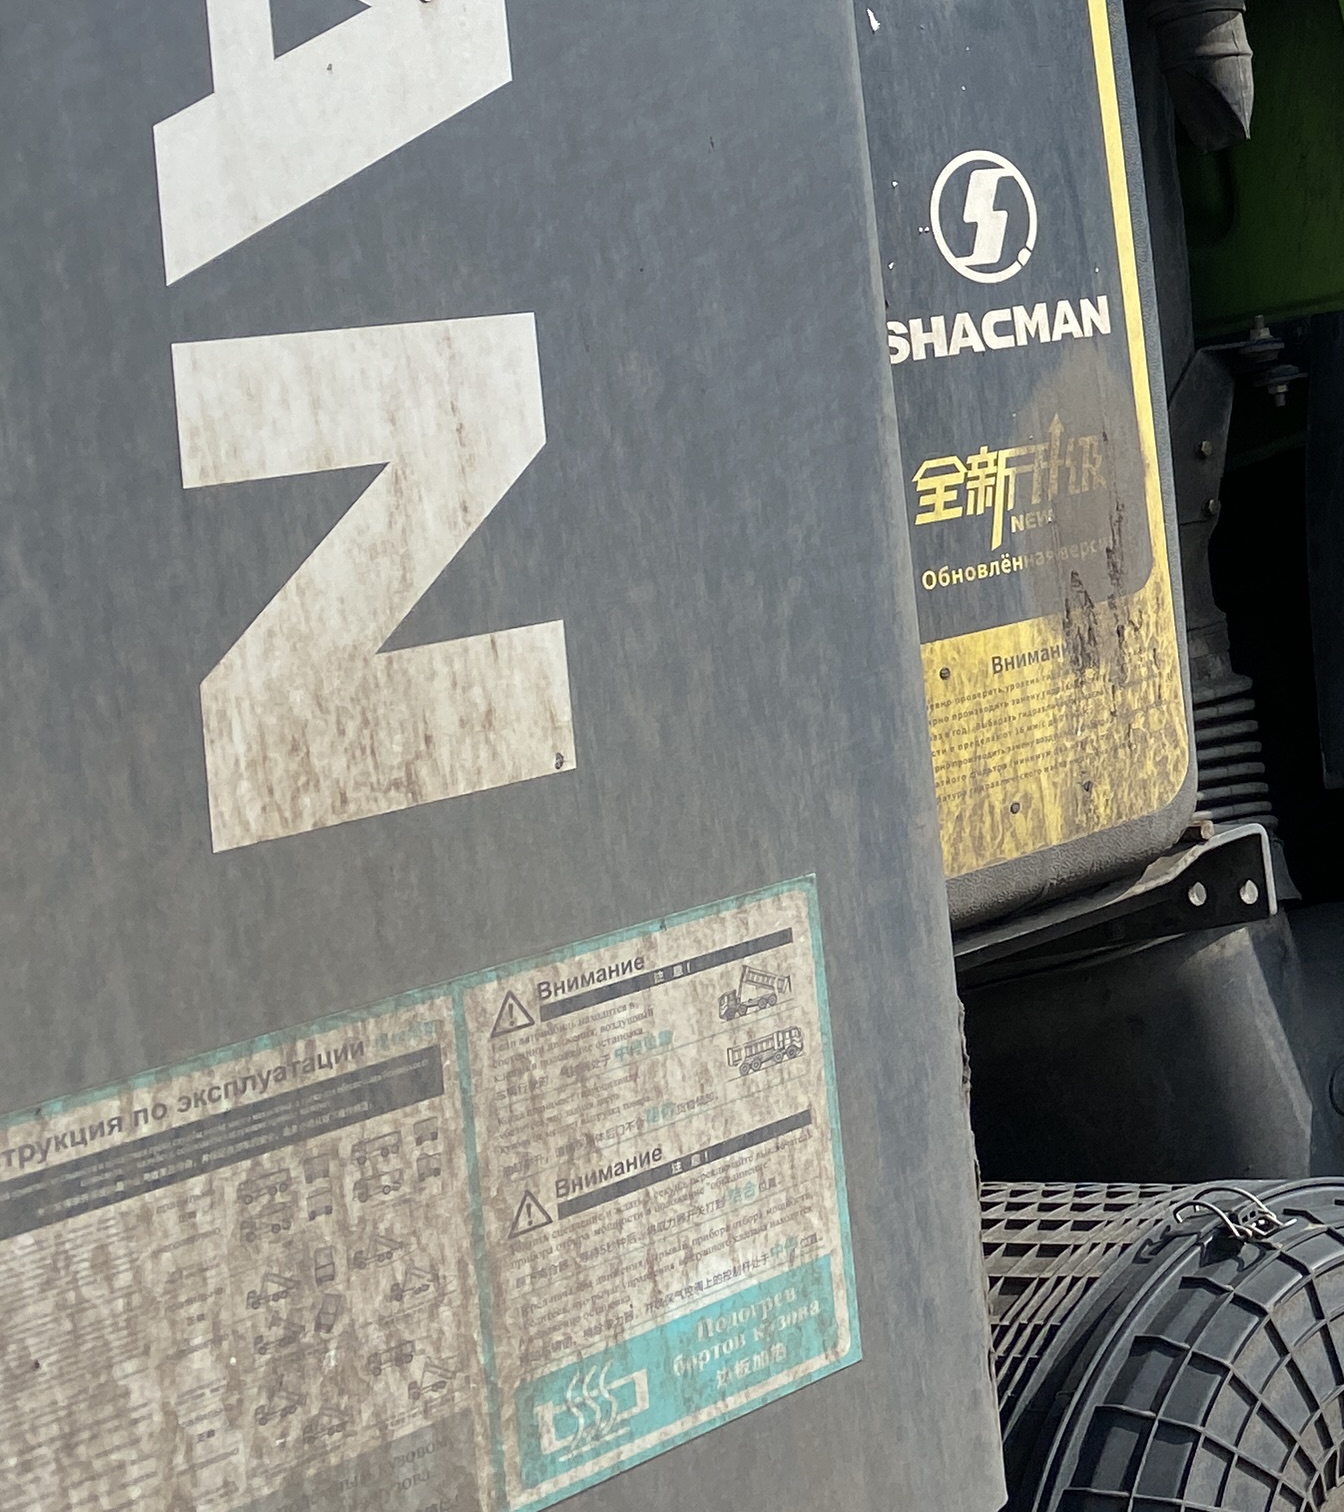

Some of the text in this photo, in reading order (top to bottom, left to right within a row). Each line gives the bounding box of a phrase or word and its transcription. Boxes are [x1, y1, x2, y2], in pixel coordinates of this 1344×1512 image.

[886, 295, 1111, 363] SHACMAN
[535, 949, 646, 1004] Внимание
[132, 1100, 168, 1128] по
[177, 1040, 365, 1115] эксплуатации
[554, 1141, 664, 1200] Внимание
